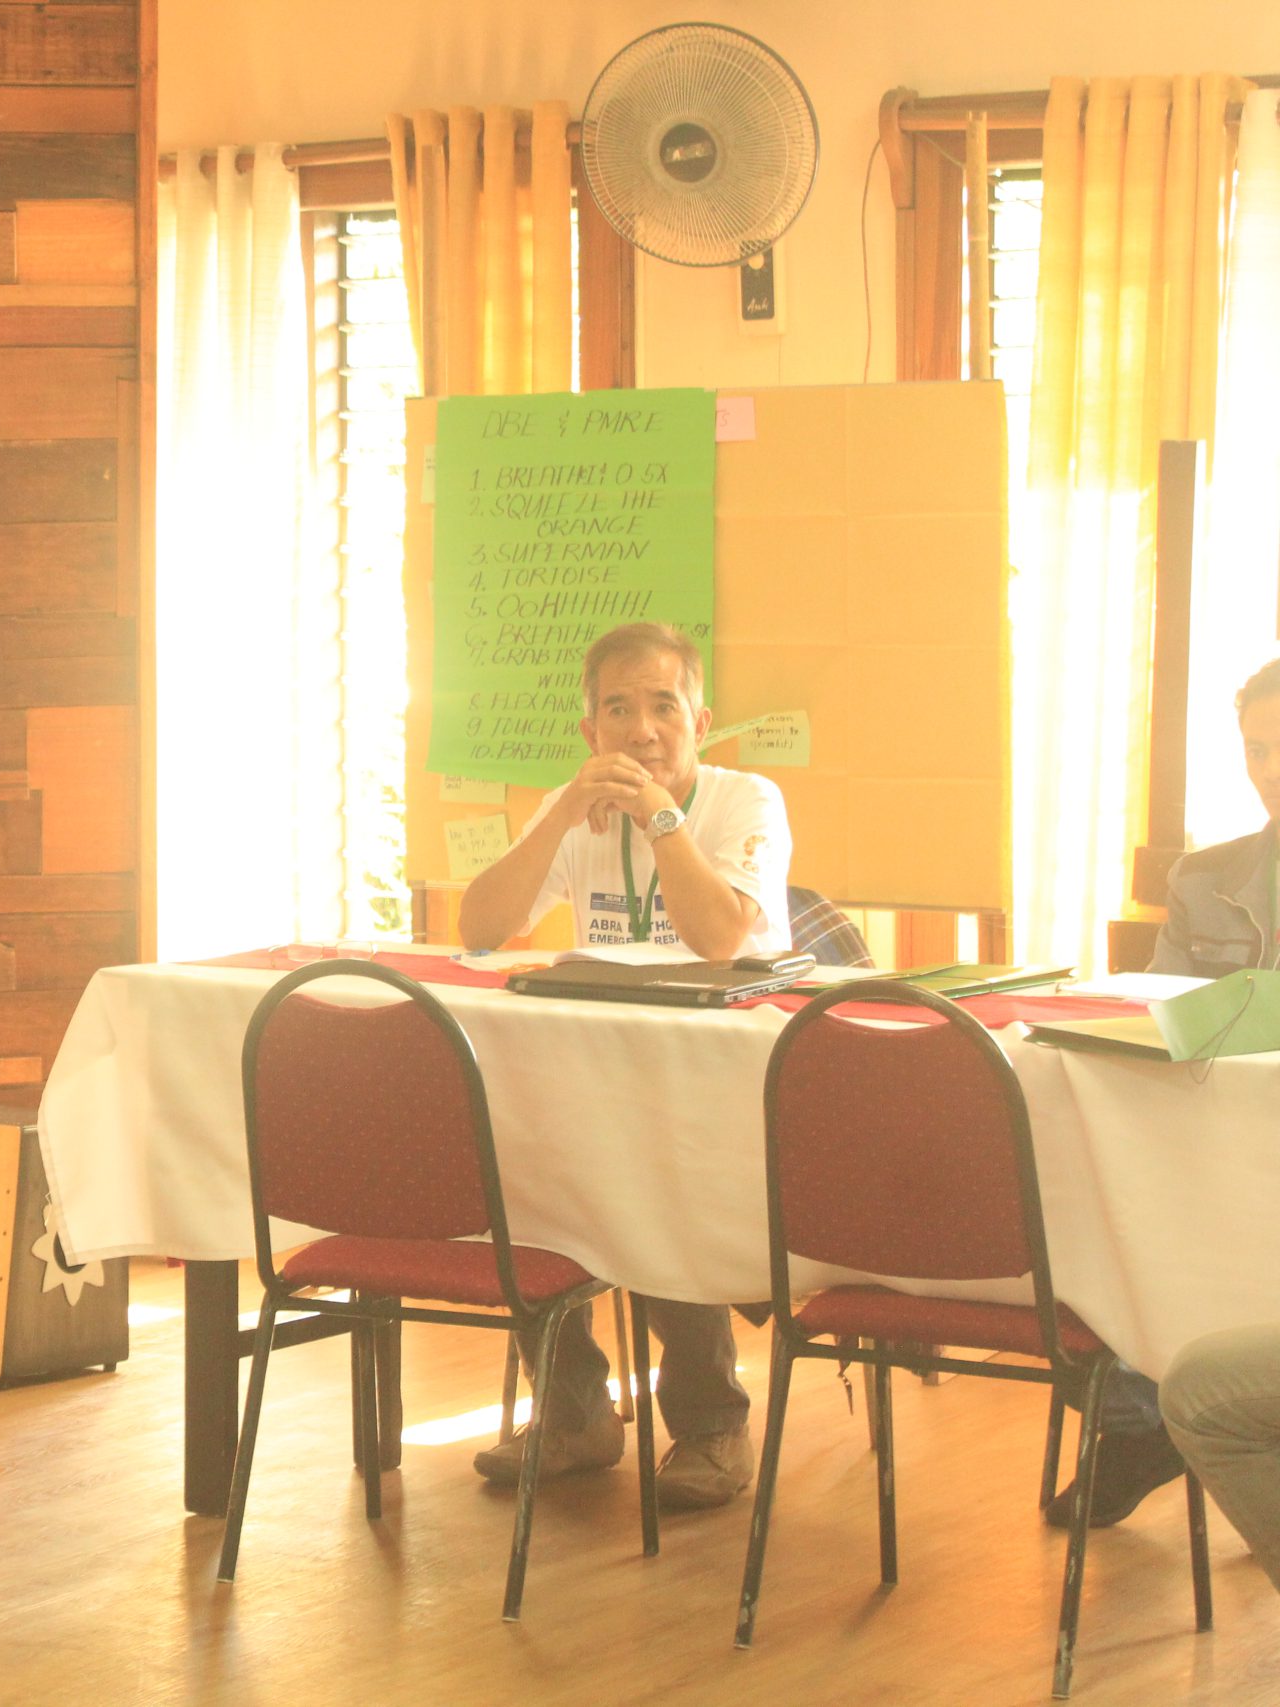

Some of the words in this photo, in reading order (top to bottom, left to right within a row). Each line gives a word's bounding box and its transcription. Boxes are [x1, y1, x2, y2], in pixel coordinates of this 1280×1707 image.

[482, 409, 542, 439] DBE
[583, 408, 666, 435] PMRE
[490, 491, 608, 520] SQUEEZE
[622, 489, 666, 510] THE
[537, 515, 647, 538] ORANGE
[493, 540, 652, 564] SUPERMAN
[501, 566, 621, 589] TORTOISE
[492, 647, 550, 666] GRAB
[556, 647, 586, 665] TISS
[490, 691, 539, 711] FLEX
[541, 692, 583, 713] ANK
[491, 717, 557, 738] TOUCH
[496, 741, 581, 761] BREATHE
[589, 918, 622, 932] ABRA
